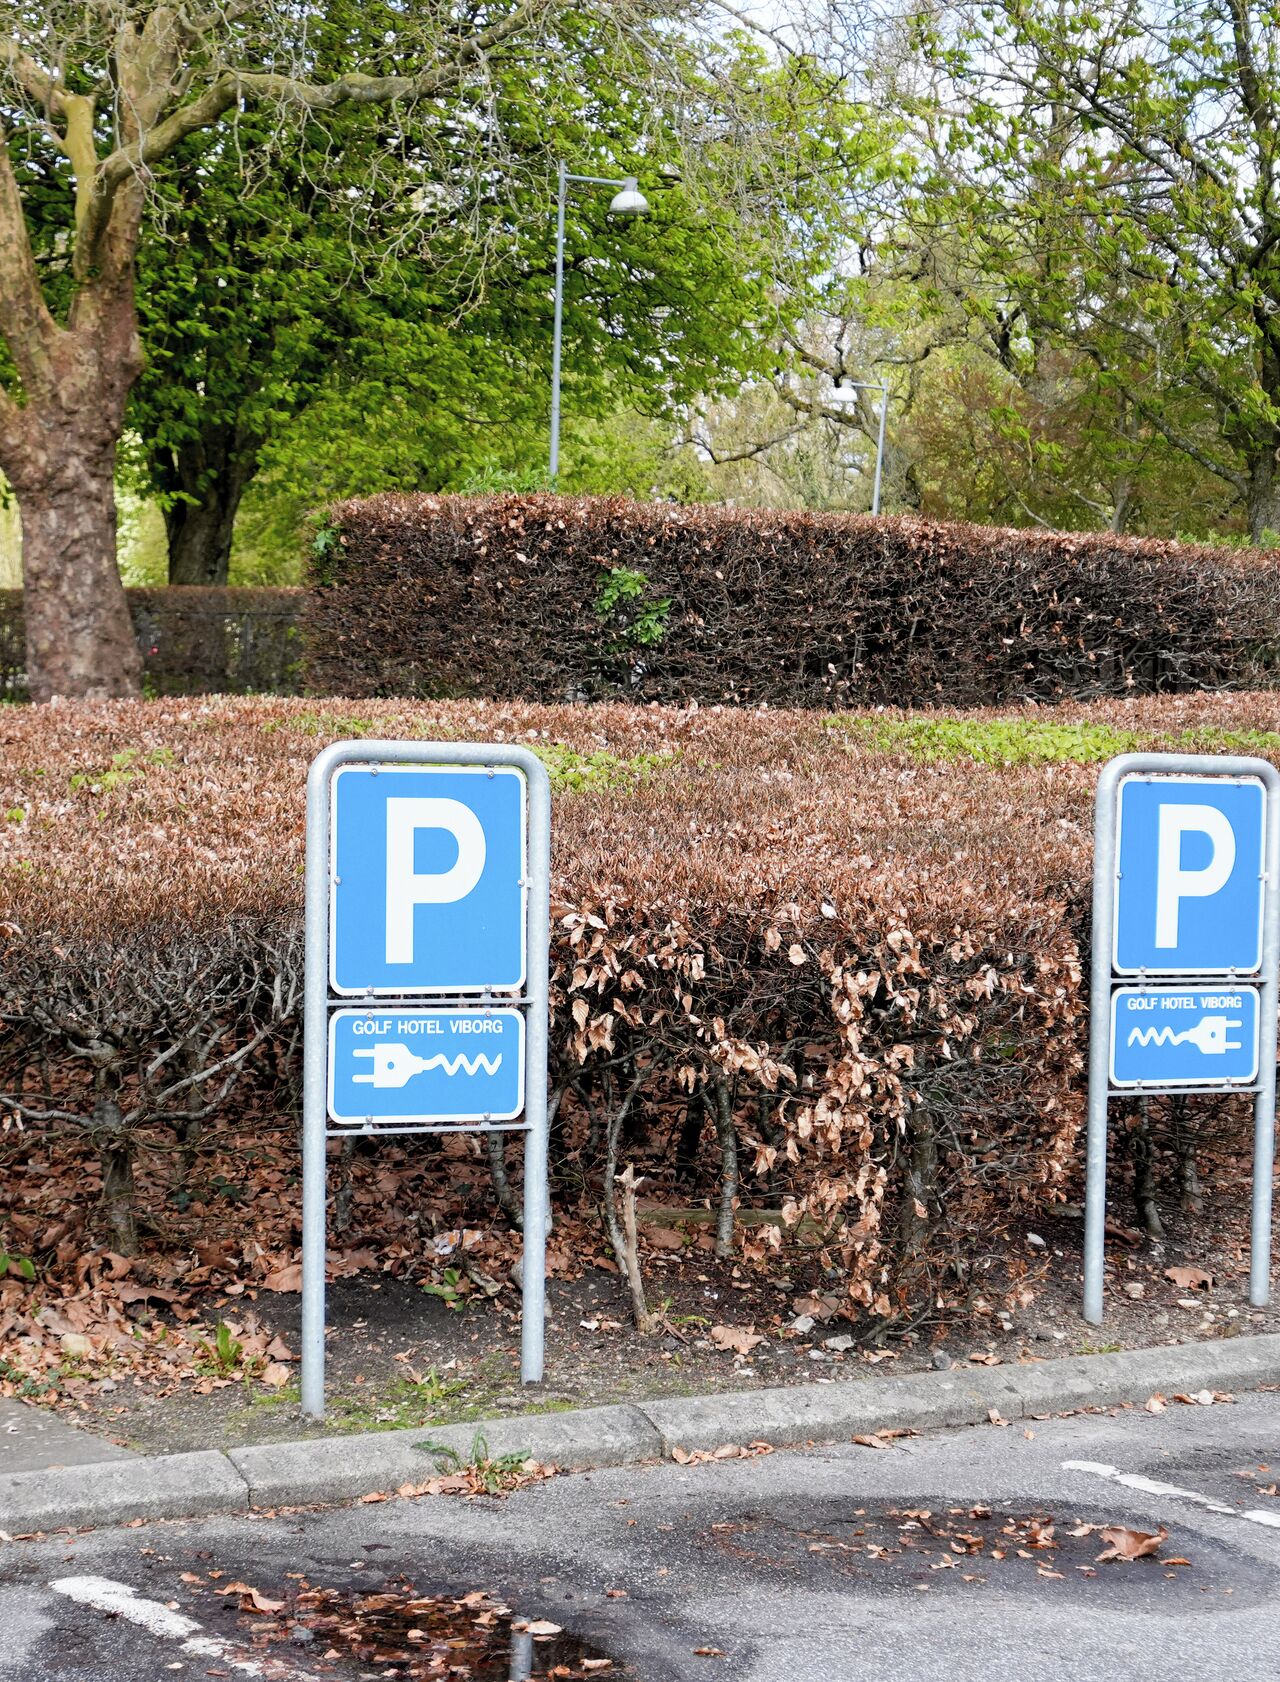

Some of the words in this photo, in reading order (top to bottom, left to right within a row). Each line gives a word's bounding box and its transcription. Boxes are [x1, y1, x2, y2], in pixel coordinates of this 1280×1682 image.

[385, 797, 487, 964] P
[1155, 803, 1237, 949] P
[352, 1020, 392, 1035] GOLF
[397, 1020, 444, 1034] HOTEL
[450, 1019, 503, 1034] VIBORG
[1127, 997, 1158, 1011] GOLF
[1161, 997, 1198, 1010] HOTEL
[1200, 996, 1242, 1009] VIBORG
